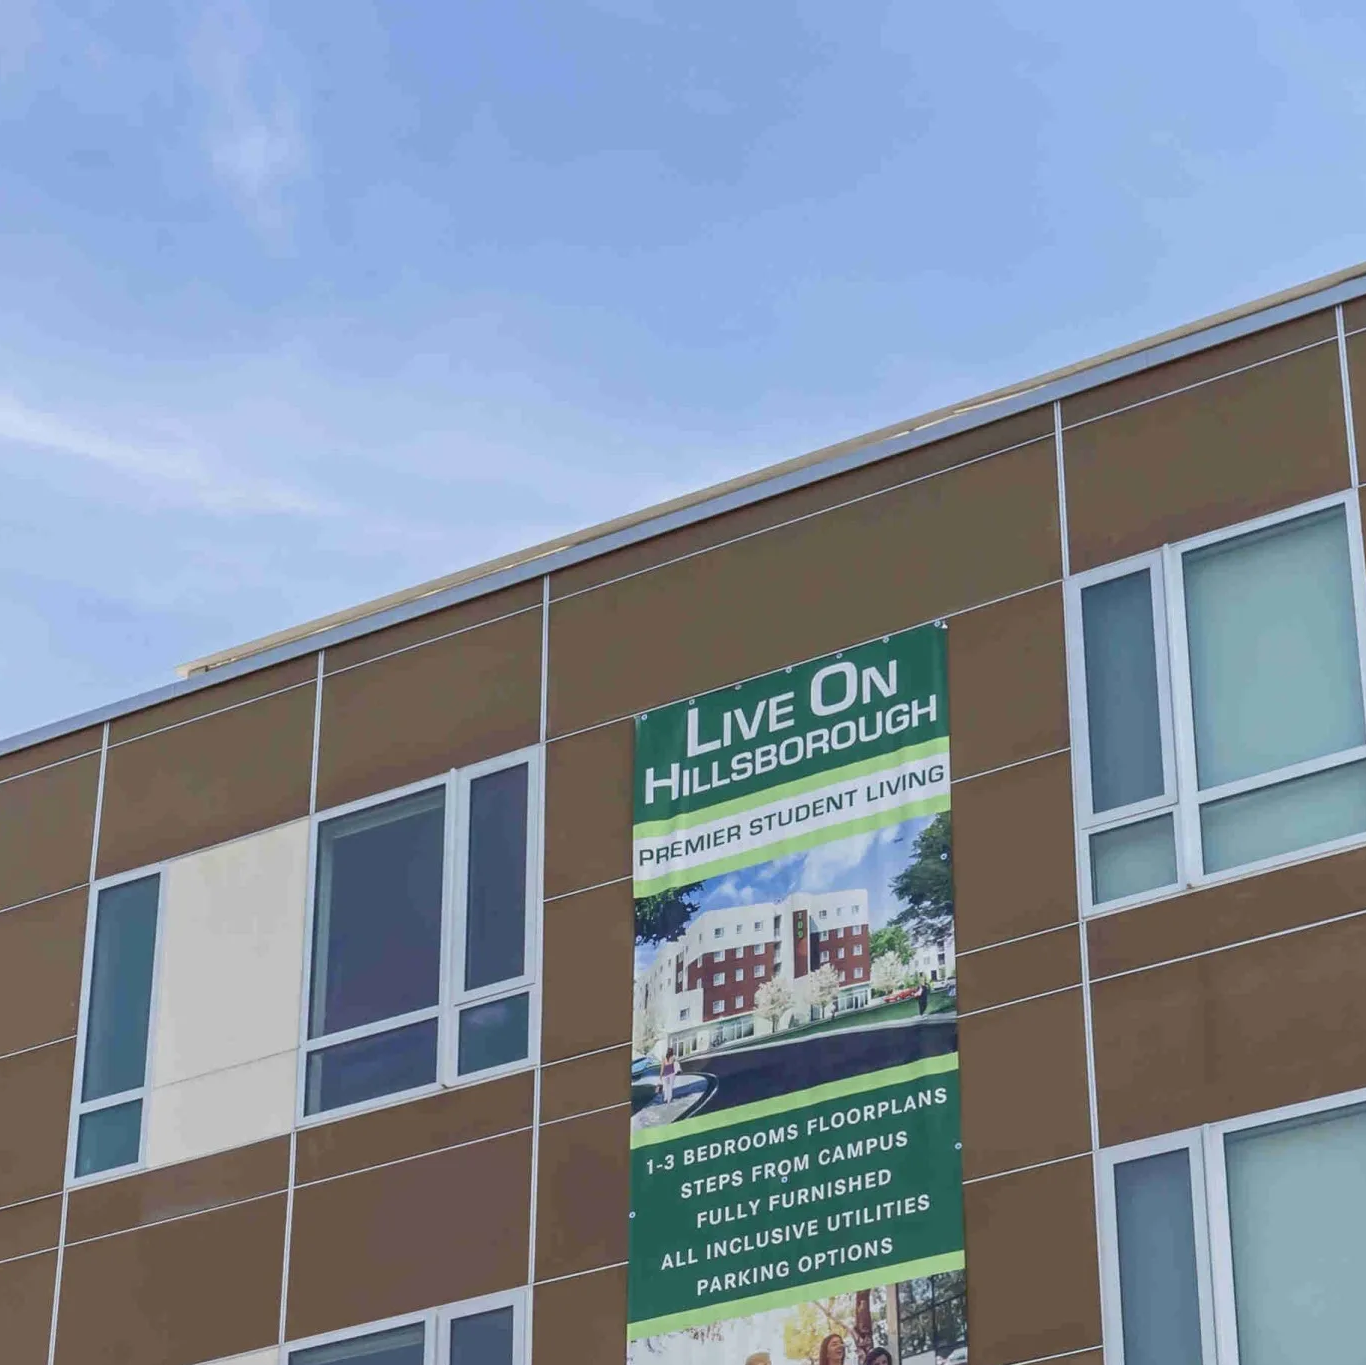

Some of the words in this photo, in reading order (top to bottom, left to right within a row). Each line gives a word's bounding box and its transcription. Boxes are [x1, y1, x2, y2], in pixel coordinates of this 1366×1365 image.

[639, 825, 740, 866] PREMIER
[750, 790, 857, 836] STUDENT
[867, 765, 944, 800] LIVING
[646, 1155, 675, 1174] 1-3
[684, 1124, 799, 1166] BEDROOMS
[807, 1087, 947, 1136] FLOORPLANS
[681, 1171, 743, 1199] STEPS
[752, 1154, 809, 1183] FROM
[818, 1131, 908, 1166] CAMPUS
[661, 1249, 698, 1270] ALL
[707, 1221, 819, 1260] INCLUSIVE
[828, 1194, 931, 1231] UTILITIES
[696, 1199, 760, 1229] FULLY
[769, 1169, 892, 1211] FURNISHED
[697, 1261, 789, 1296] PARKING
[798, 1237, 894, 1273] OPTIONS
